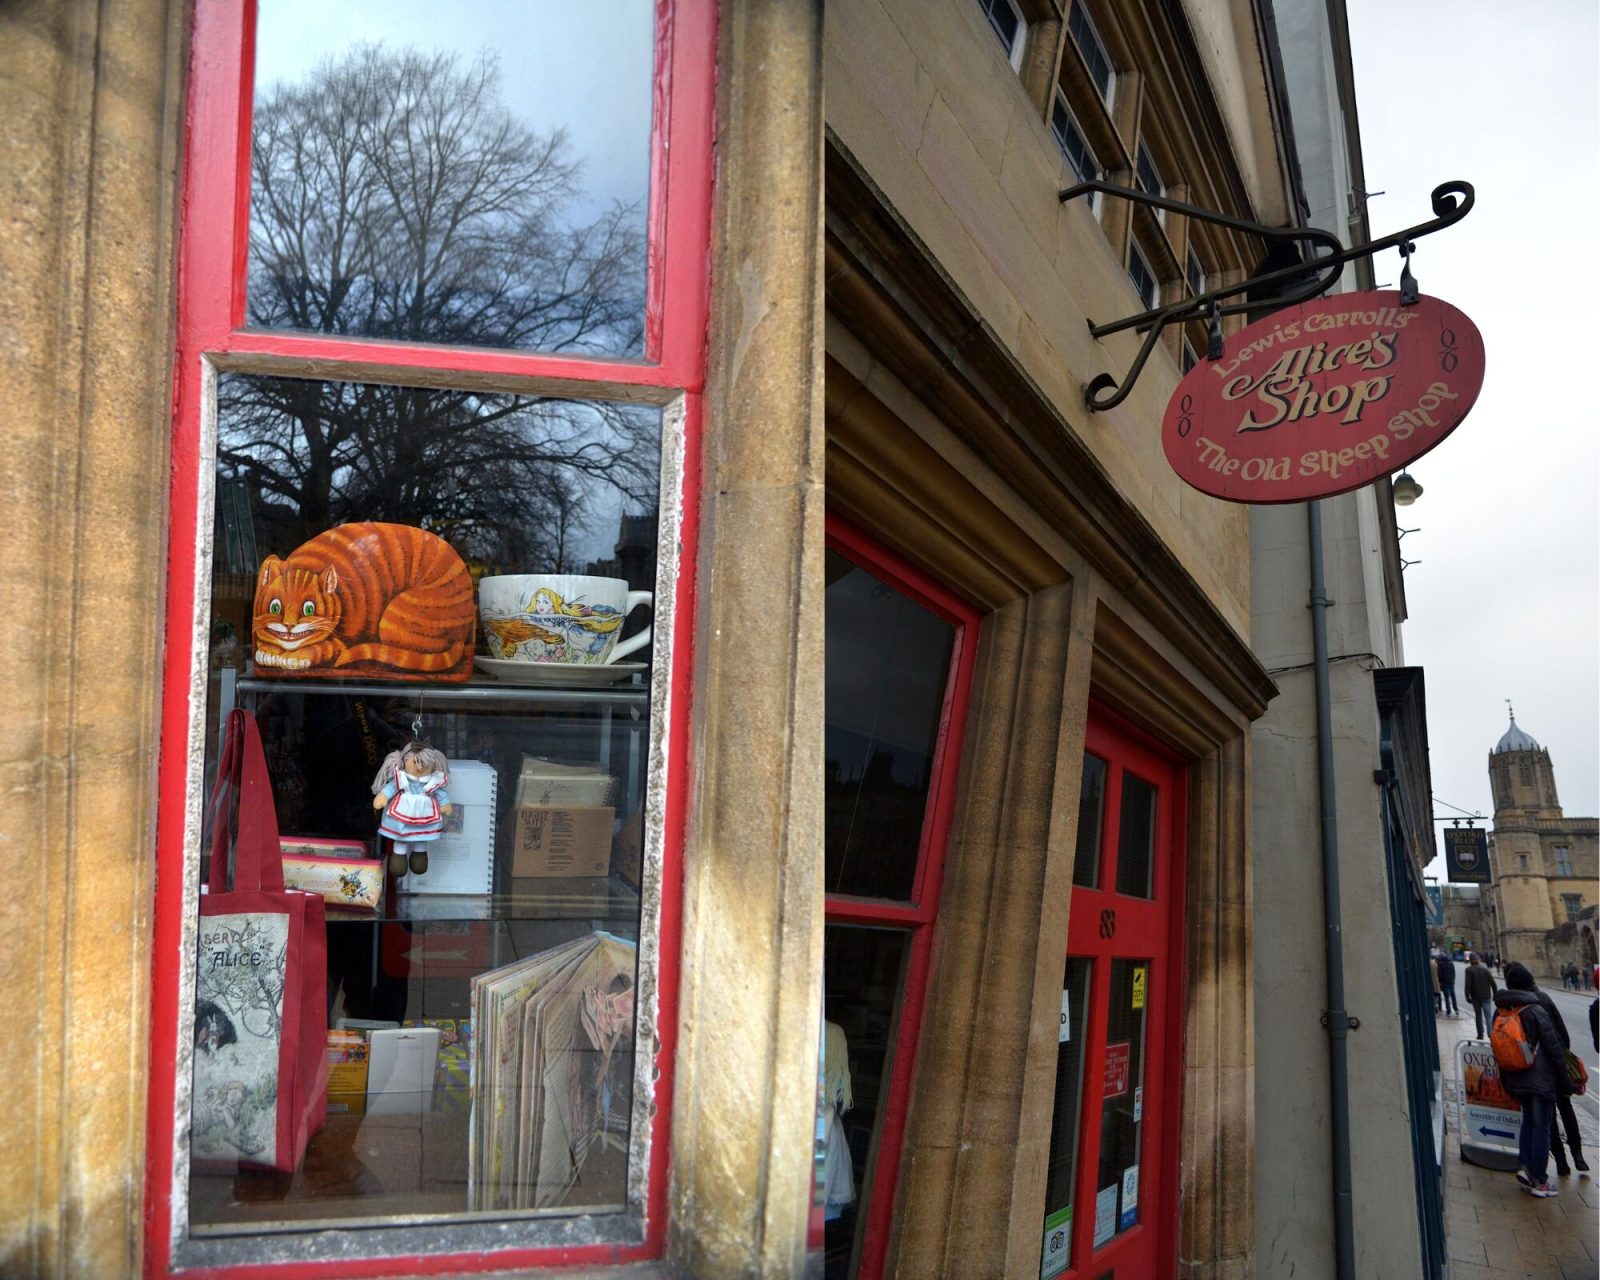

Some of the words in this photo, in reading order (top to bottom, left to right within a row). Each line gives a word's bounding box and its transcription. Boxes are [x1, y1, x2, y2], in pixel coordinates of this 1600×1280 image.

[1211, 320, 1301, 379] Lewis
[1221, 331, 1399, 401] Alice's
[1196, 437, 1240, 475] The
[1240, 458, 1291, 480] Old
[1299, 434, 1390, 479] Sheep
[1387, 381, 1458, 440] Shop
[1238, 374, 1395, 433] Shop
